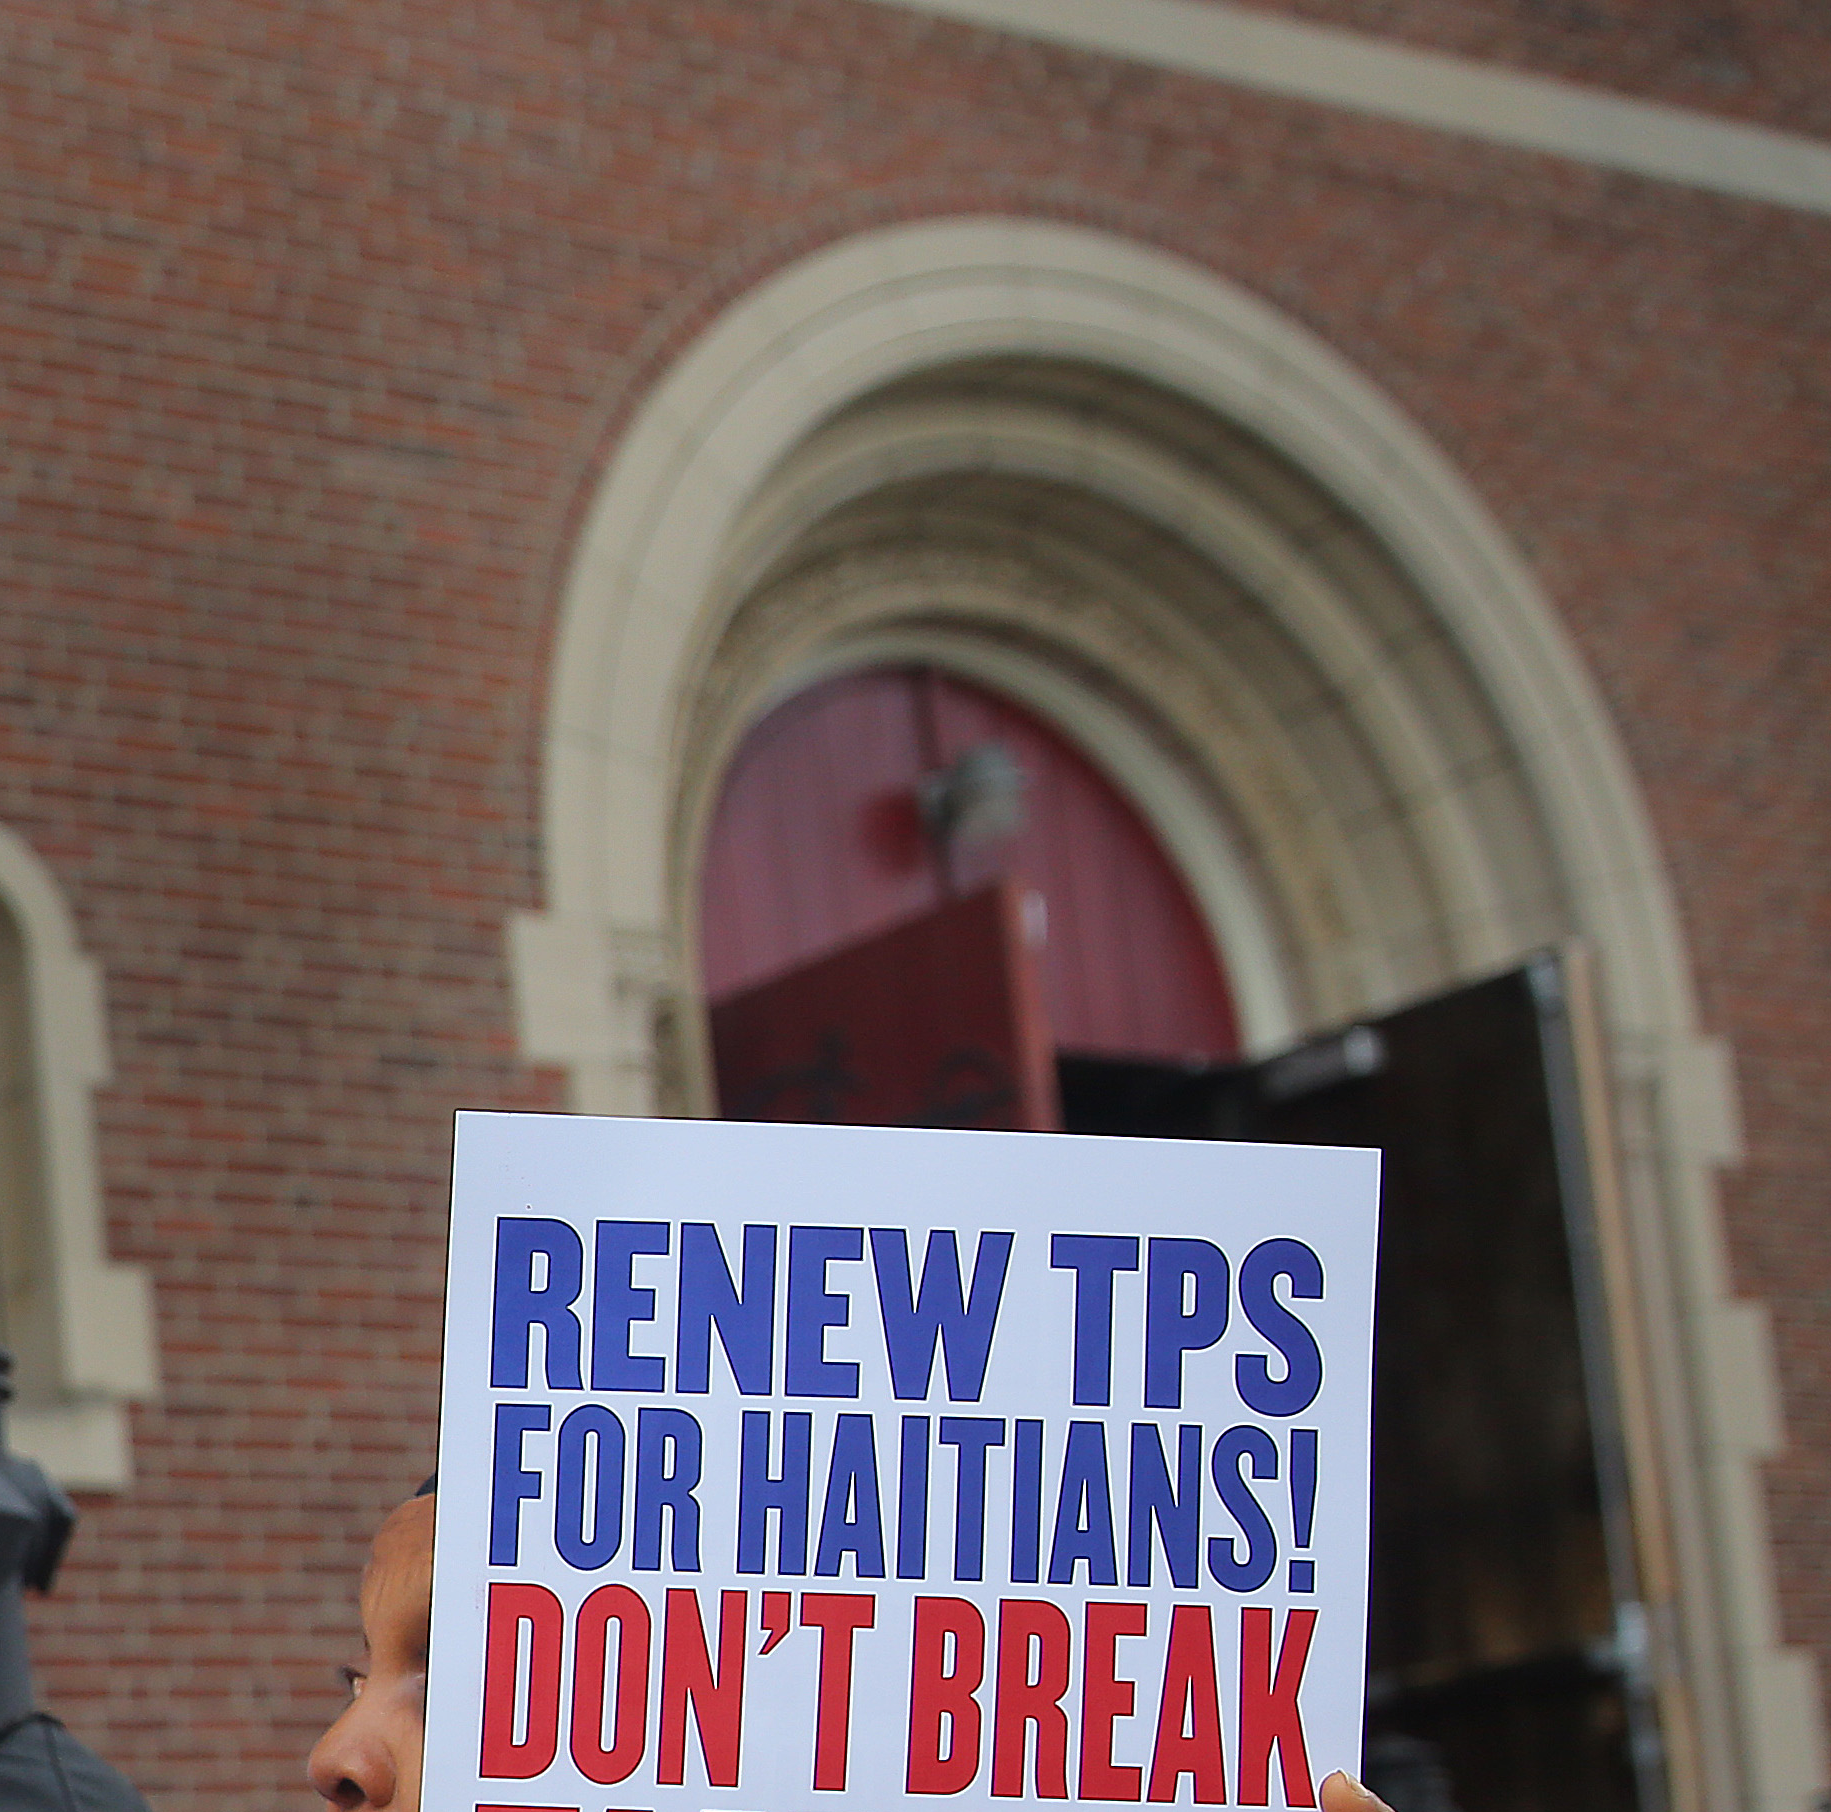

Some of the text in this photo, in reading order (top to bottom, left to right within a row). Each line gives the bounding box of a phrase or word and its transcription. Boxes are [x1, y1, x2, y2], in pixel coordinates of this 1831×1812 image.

[489, 1216, 1324, 1417] RENEW TPS
[488, 1402, 1319, 1594] FOR HAITIANS!
[478, 1581, 1320, 1809] DON'T BREAK
